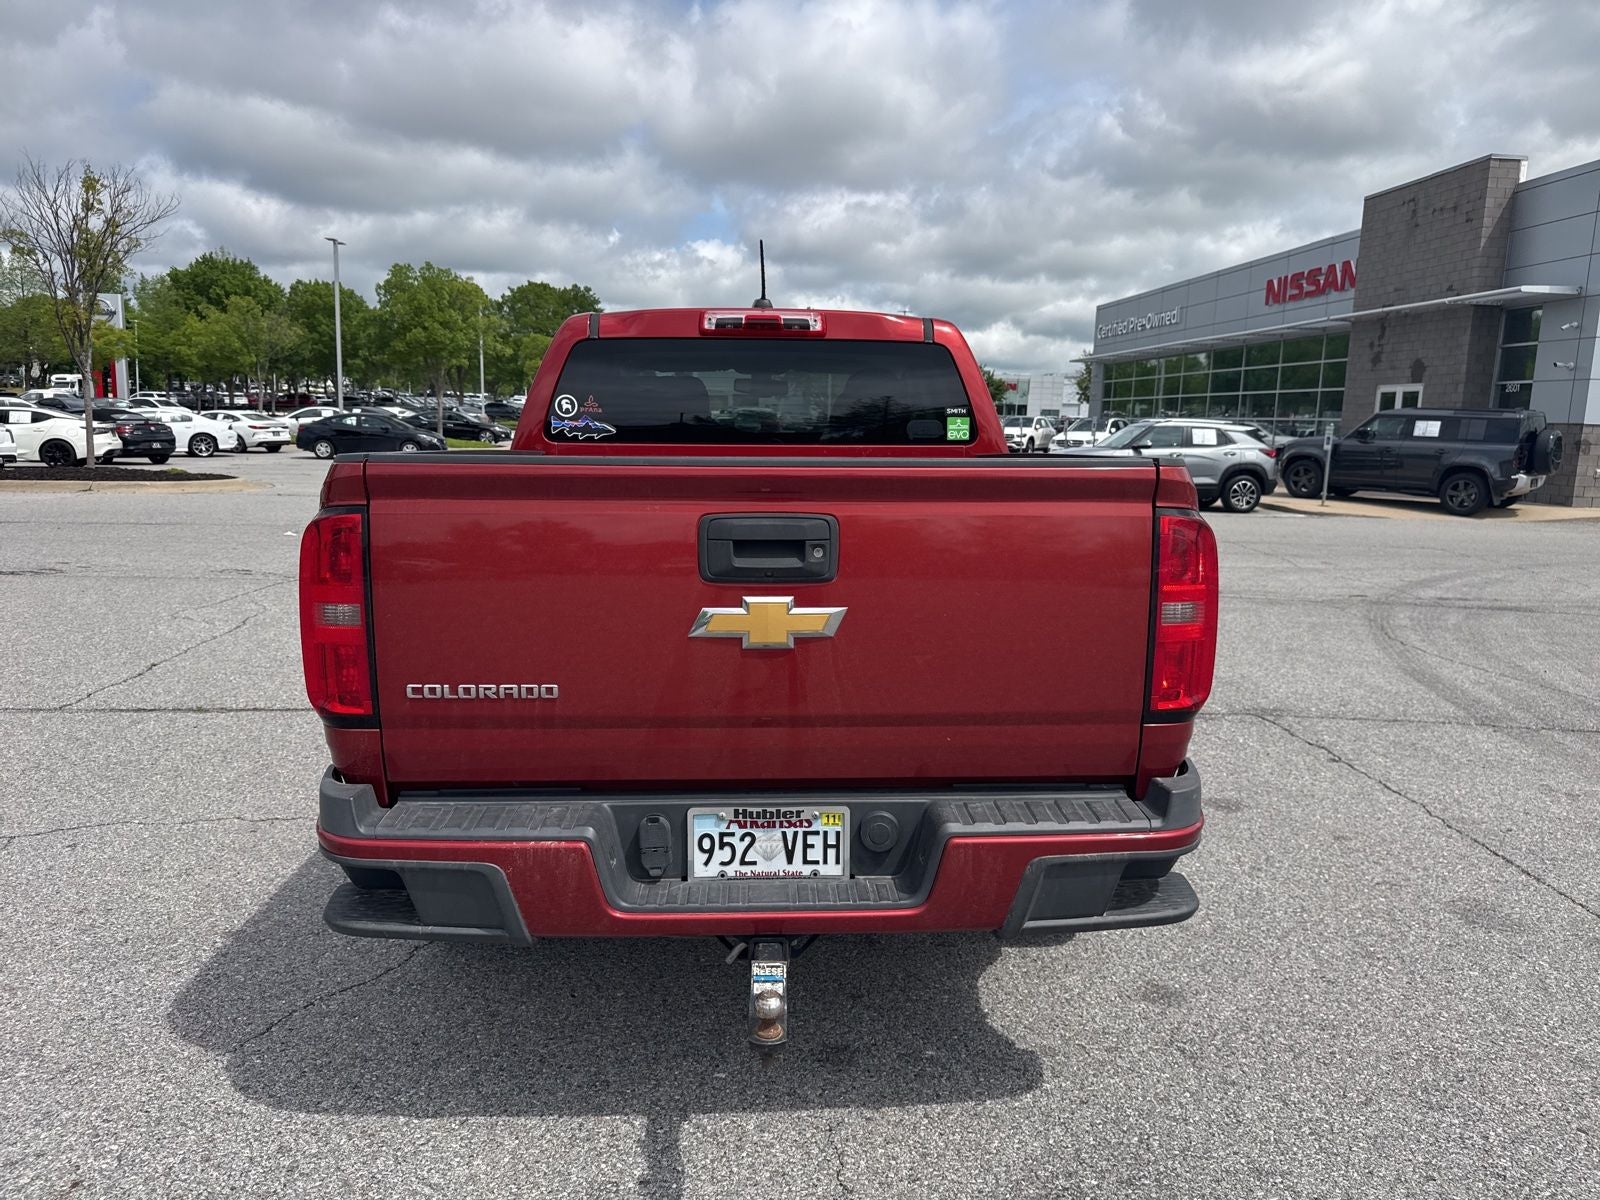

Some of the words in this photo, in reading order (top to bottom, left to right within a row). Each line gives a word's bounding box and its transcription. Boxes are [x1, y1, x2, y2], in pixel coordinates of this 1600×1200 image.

[1265, 260, 1357, 306] NISSAN
[1096, 319, 1128, 339] Certified
[1129, 306, 1179, 333] Pre-Owned
[946, 407, 967, 415] SMITH
[948, 430, 969, 439] evo
[406, 684, 559, 698] COLORADO
[733, 808, 805, 820] Hubler
[725, 818, 813, 830] Arkansas
[697, 831, 758, 866] 952
[781, 831, 841, 865] VEH
[734, 869, 748, 877] The
[750, 869, 780, 877] Natural
[782, 869, 803, 877] State
